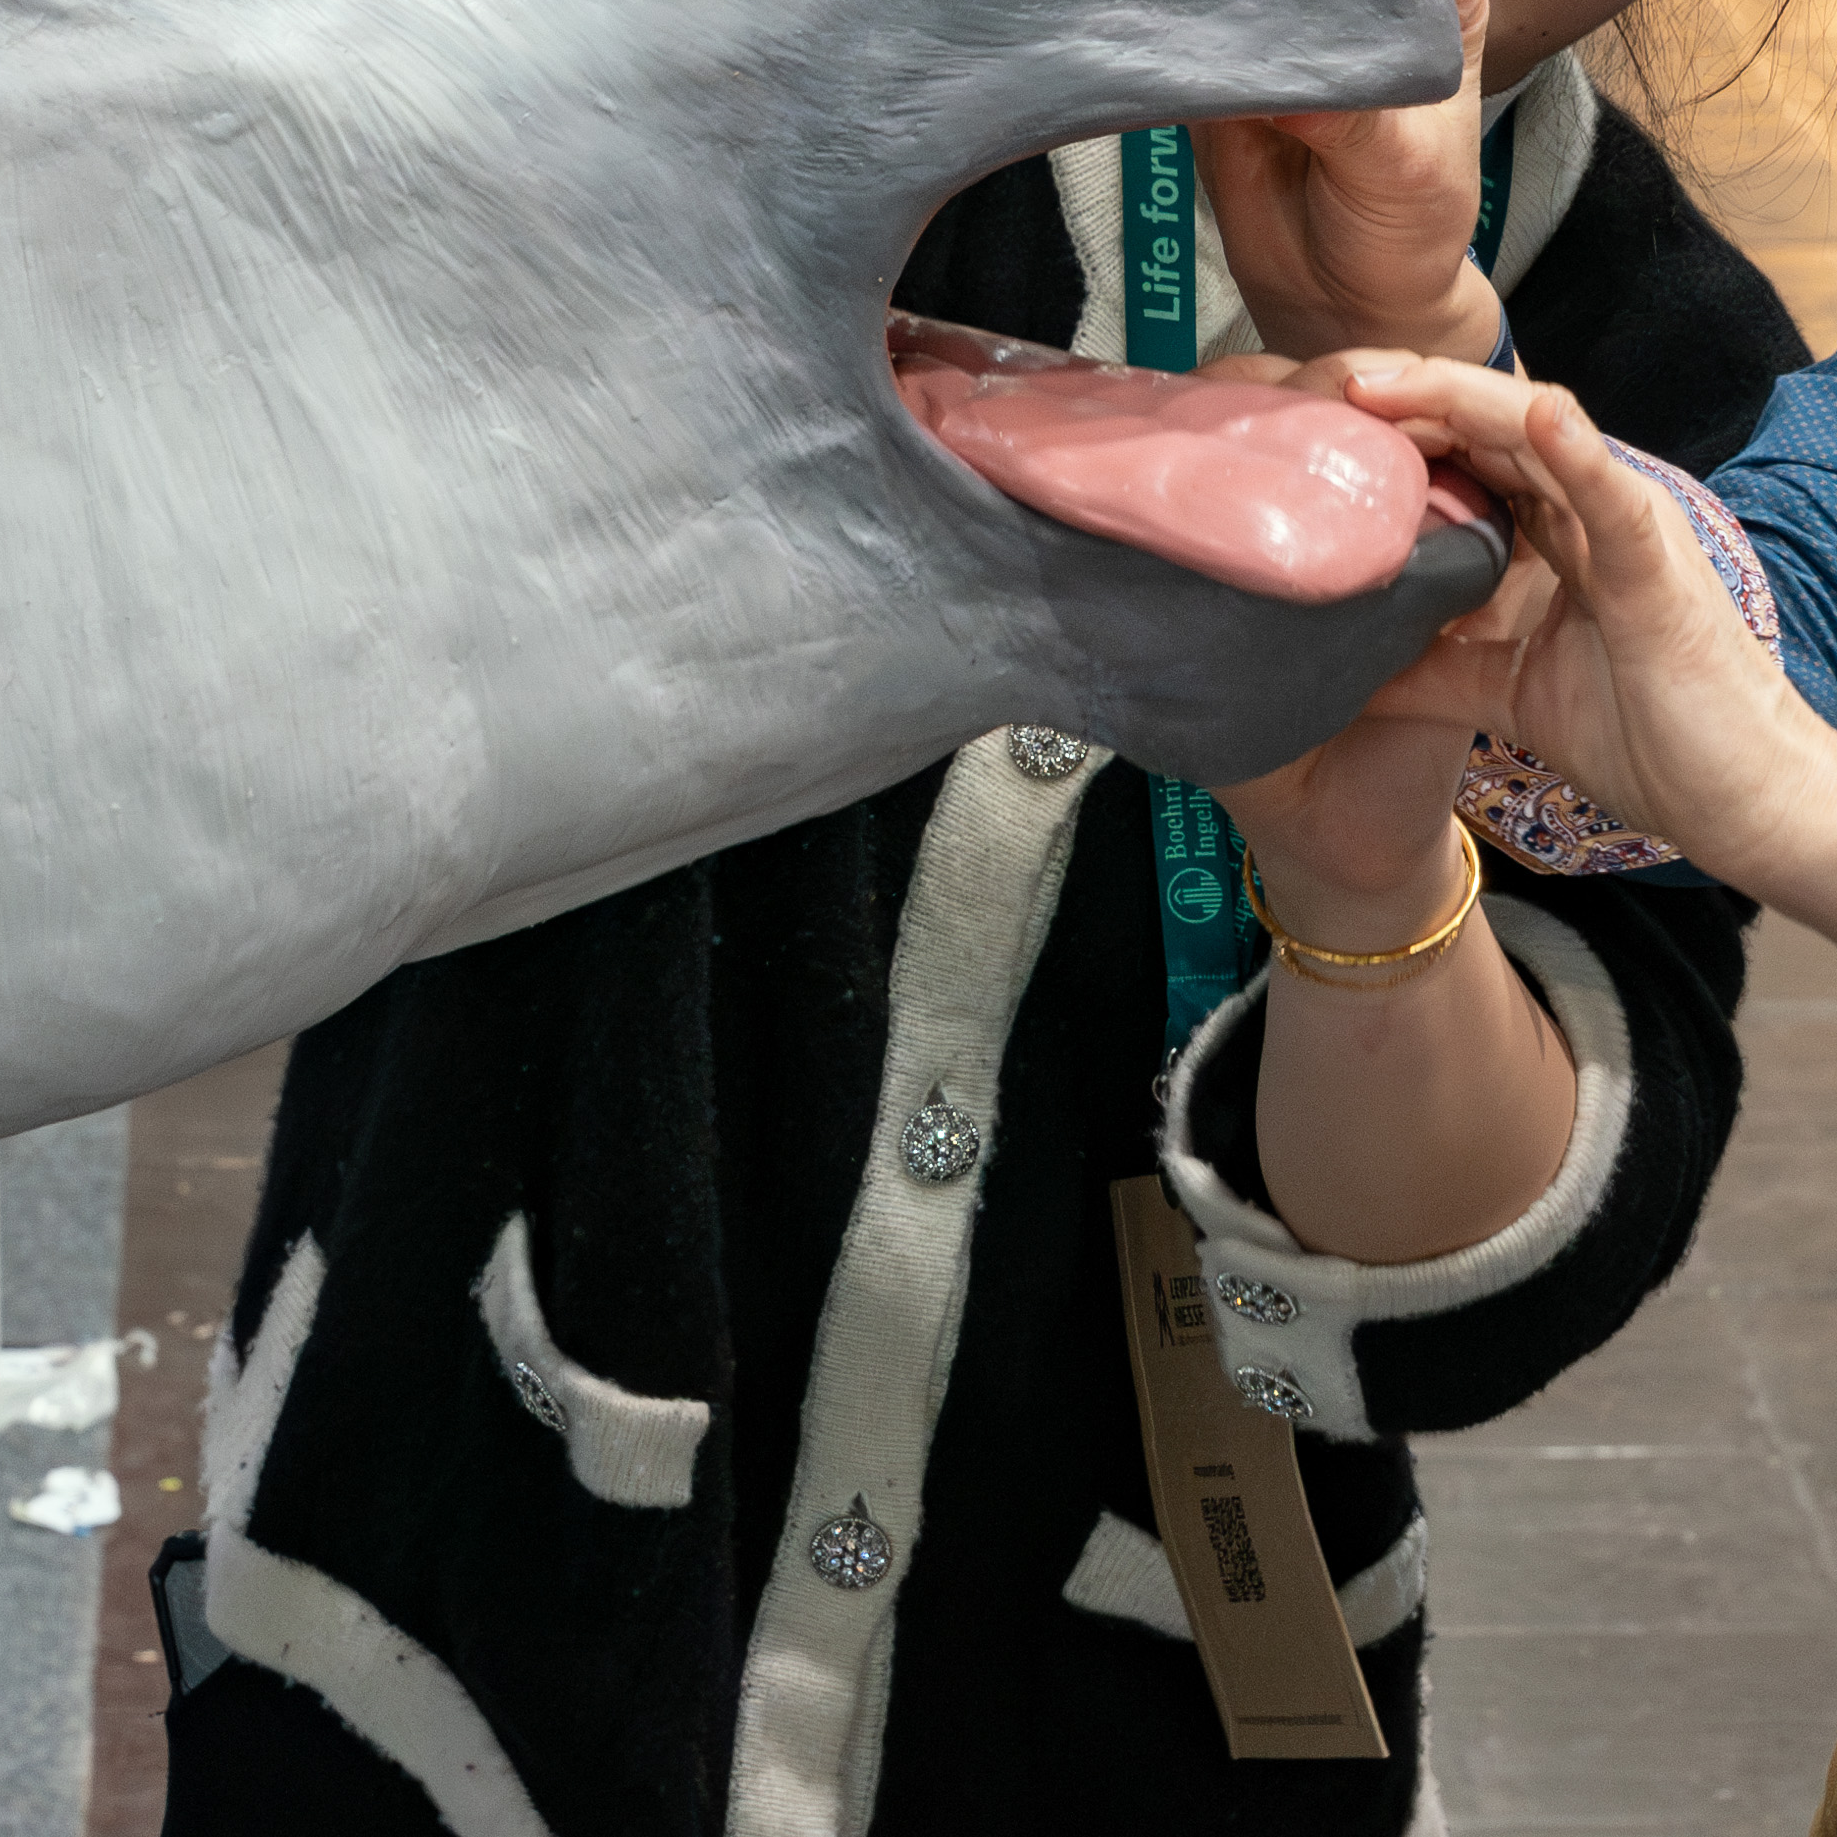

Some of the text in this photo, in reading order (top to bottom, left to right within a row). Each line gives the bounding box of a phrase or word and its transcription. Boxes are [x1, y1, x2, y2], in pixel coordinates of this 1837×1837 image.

[1140, 125, 1180, 322] Life forw
[1159, 775, 1188, 861] Boehri
[1189, 788, 1220, 858] Ingelh
